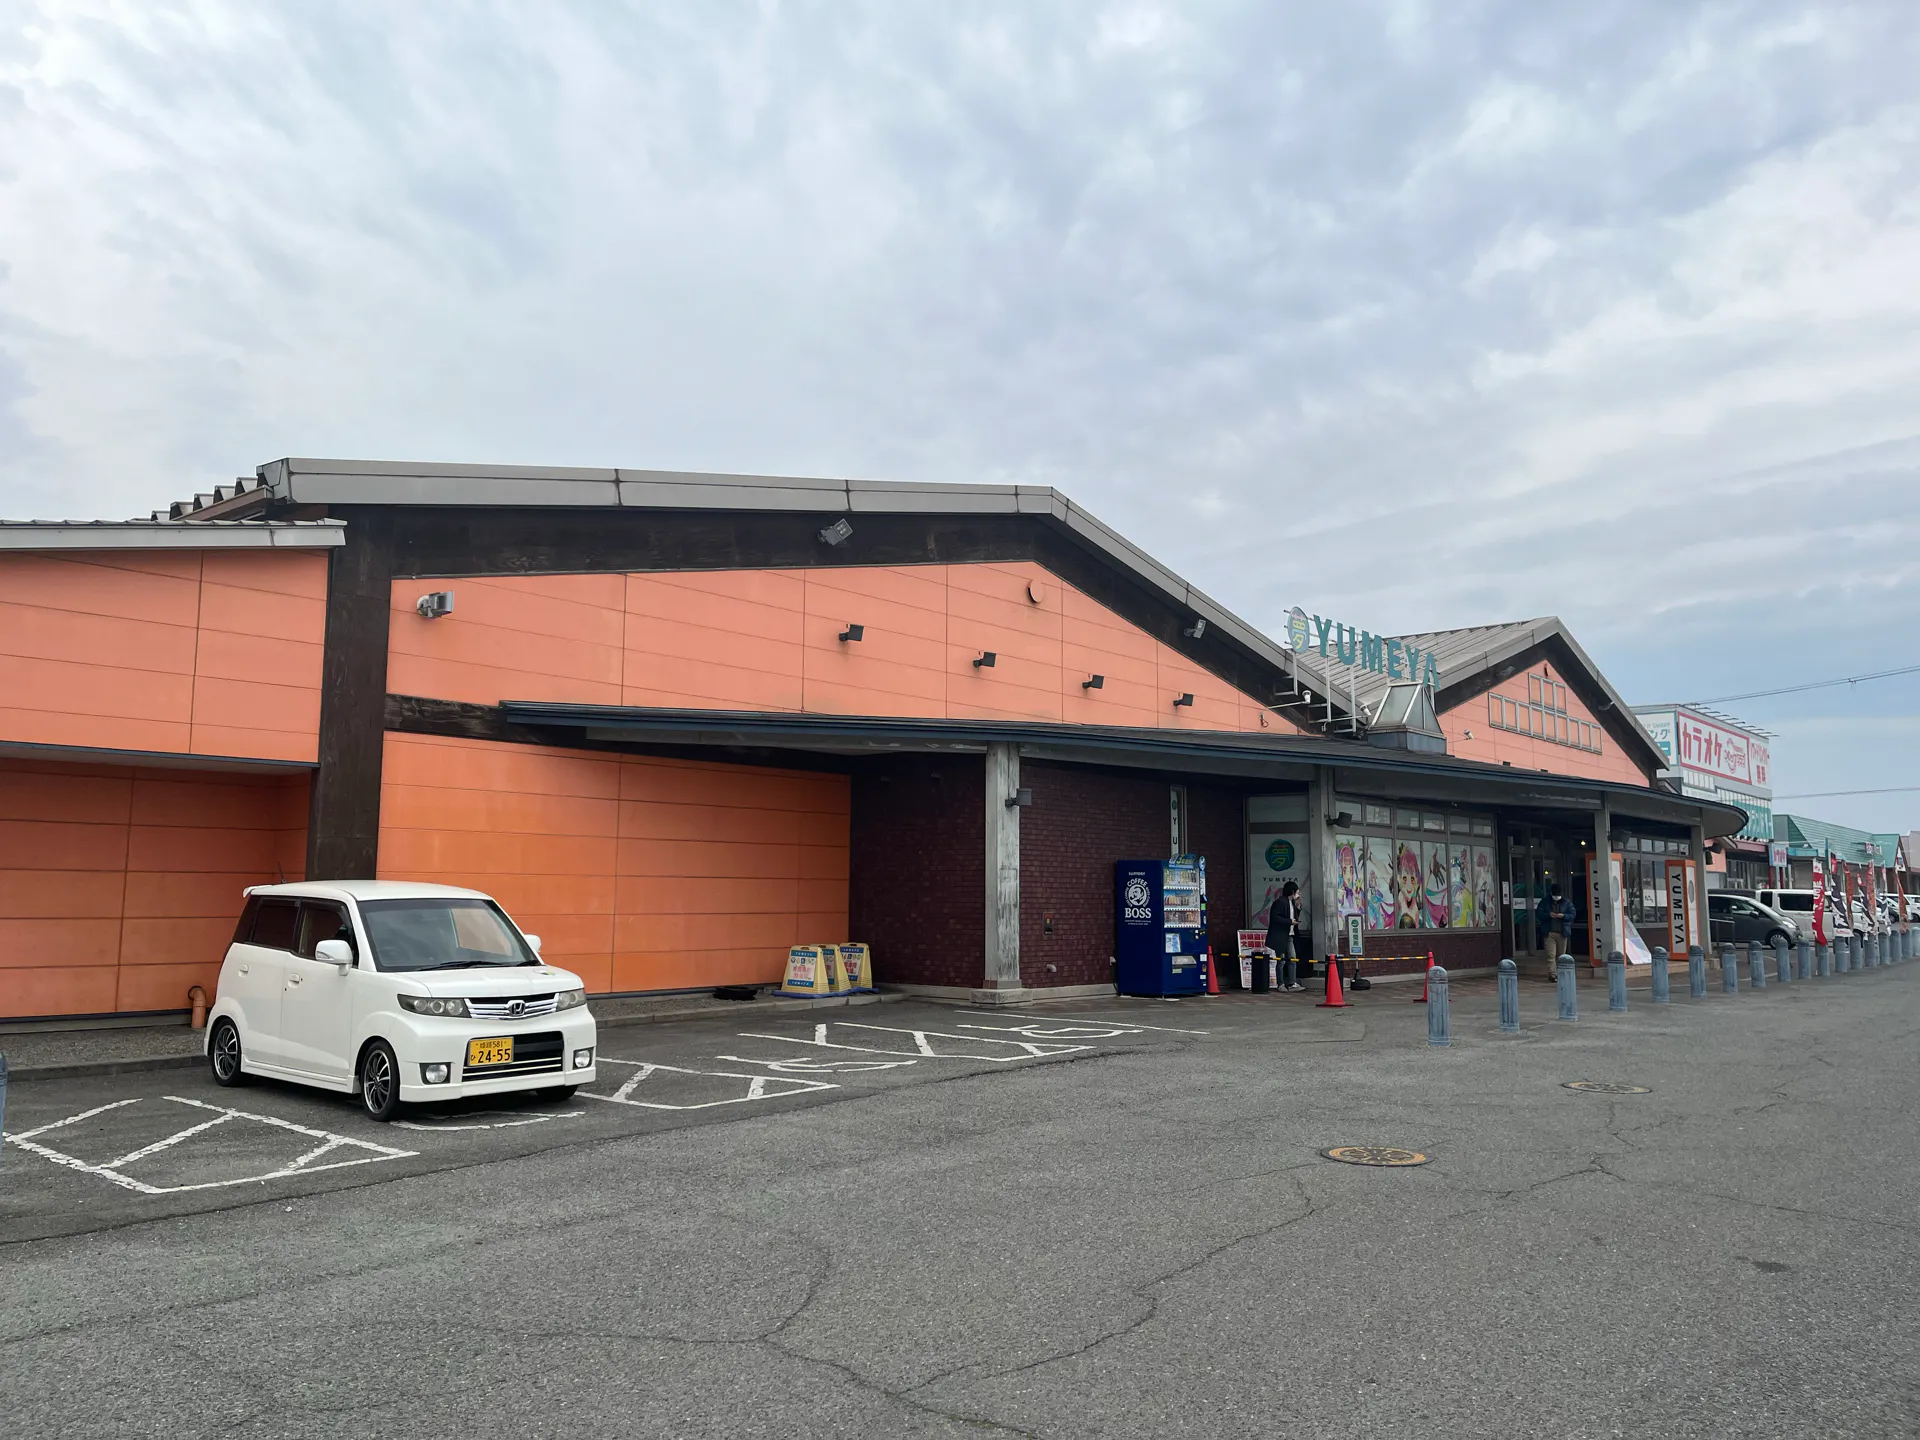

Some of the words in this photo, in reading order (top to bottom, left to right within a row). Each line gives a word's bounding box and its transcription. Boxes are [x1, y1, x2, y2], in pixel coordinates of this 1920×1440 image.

[1313, 614, 1441, 691] YUMEYA
[1682, 722, 1722, 769] カラオケ
[1126, 877, 1149, 889] COFFEE
[1124, 907, 1152, 919] BOSS
[1671, 873, 1685, 945] YUMEYA
[478, 1048, 511, 1063] 24-55
